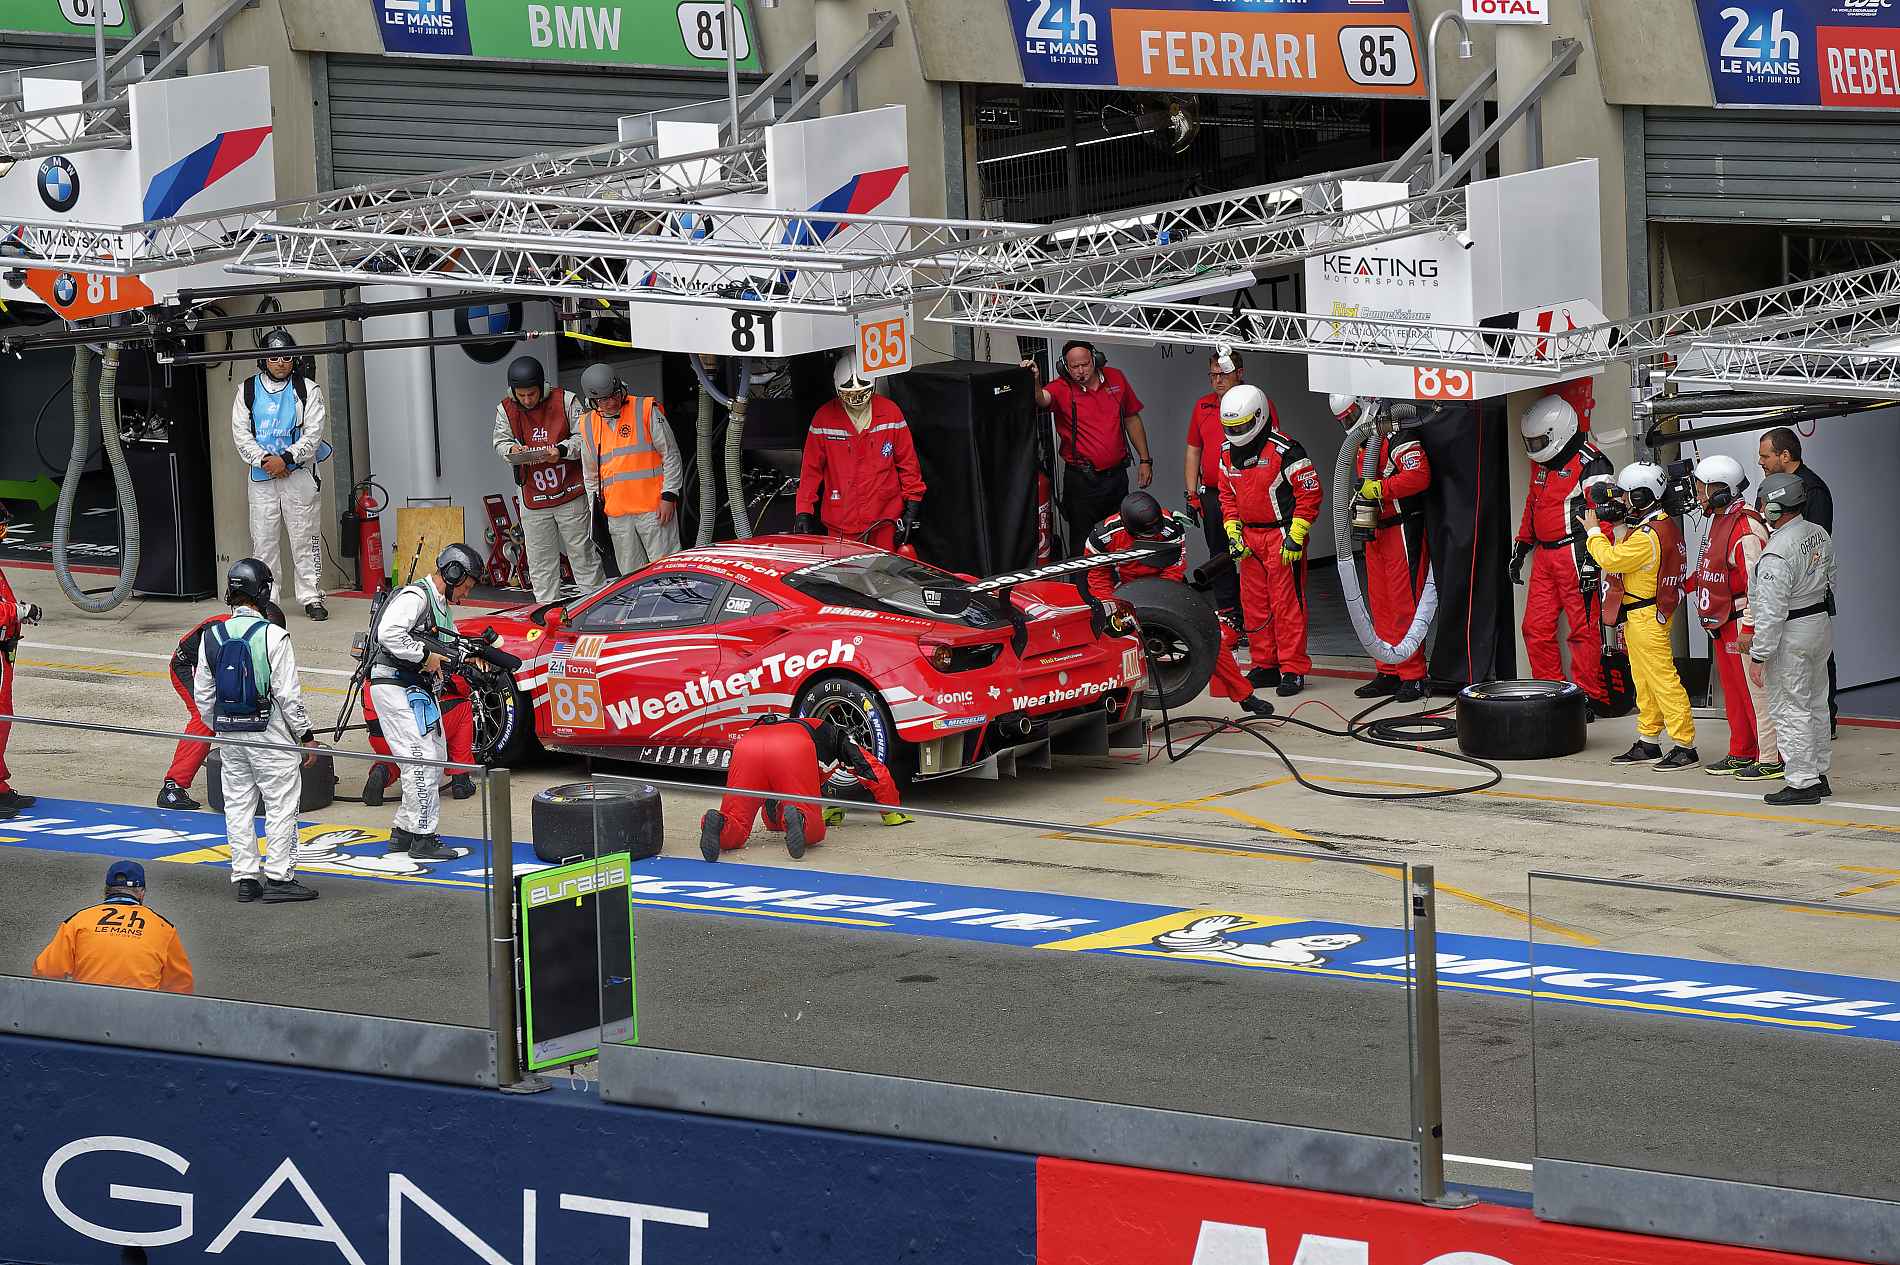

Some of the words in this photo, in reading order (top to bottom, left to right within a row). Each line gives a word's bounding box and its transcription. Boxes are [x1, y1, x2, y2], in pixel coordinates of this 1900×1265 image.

[385, 12, 405, 25] LE
[407, 13, 453, 28] MANS
[528, 5, 621, 50] BMW
[697, 10, 728, 50] 81
[1720, 7, 1799, 59] 24h
[1026, 41, 1046, 54] LE
[1049, 42, 1098, 56] MANS
[1140, 30, 1317, 79] FERRARI
[1359, 35, 1397, 77] 85
[1720, 59, 1743, 74] LE
[1746, 61, 1800, 76] MANS
[1323, 254, 1438, 278] KEATING
[1324, 274, 1439, 287] MOTORSPORTS
[87, 272, 118, 303] 81
[731, 310, 775, 352] 81
[864, 323, 902, 368] 85
[1417, 367, 1469, 397] 85
[533, 464, 566, 491] 897
[1702, 571, 1725, 583] TRACK
[726, 599, 752, 611] OMP
[818, 605, 880, 619] pakelo
[566, 664, 595, 675] TOTAL
[554, 683, 598, 723] 85
[1012, 677, 1118, 710] WeatherTech
[414, 769, 428, 830] BROADCASTER
[529, 867, 625, 904] eurasia
[110, 927, 143, 937] MANS
[42, 1136, 709, 1265] GANT
